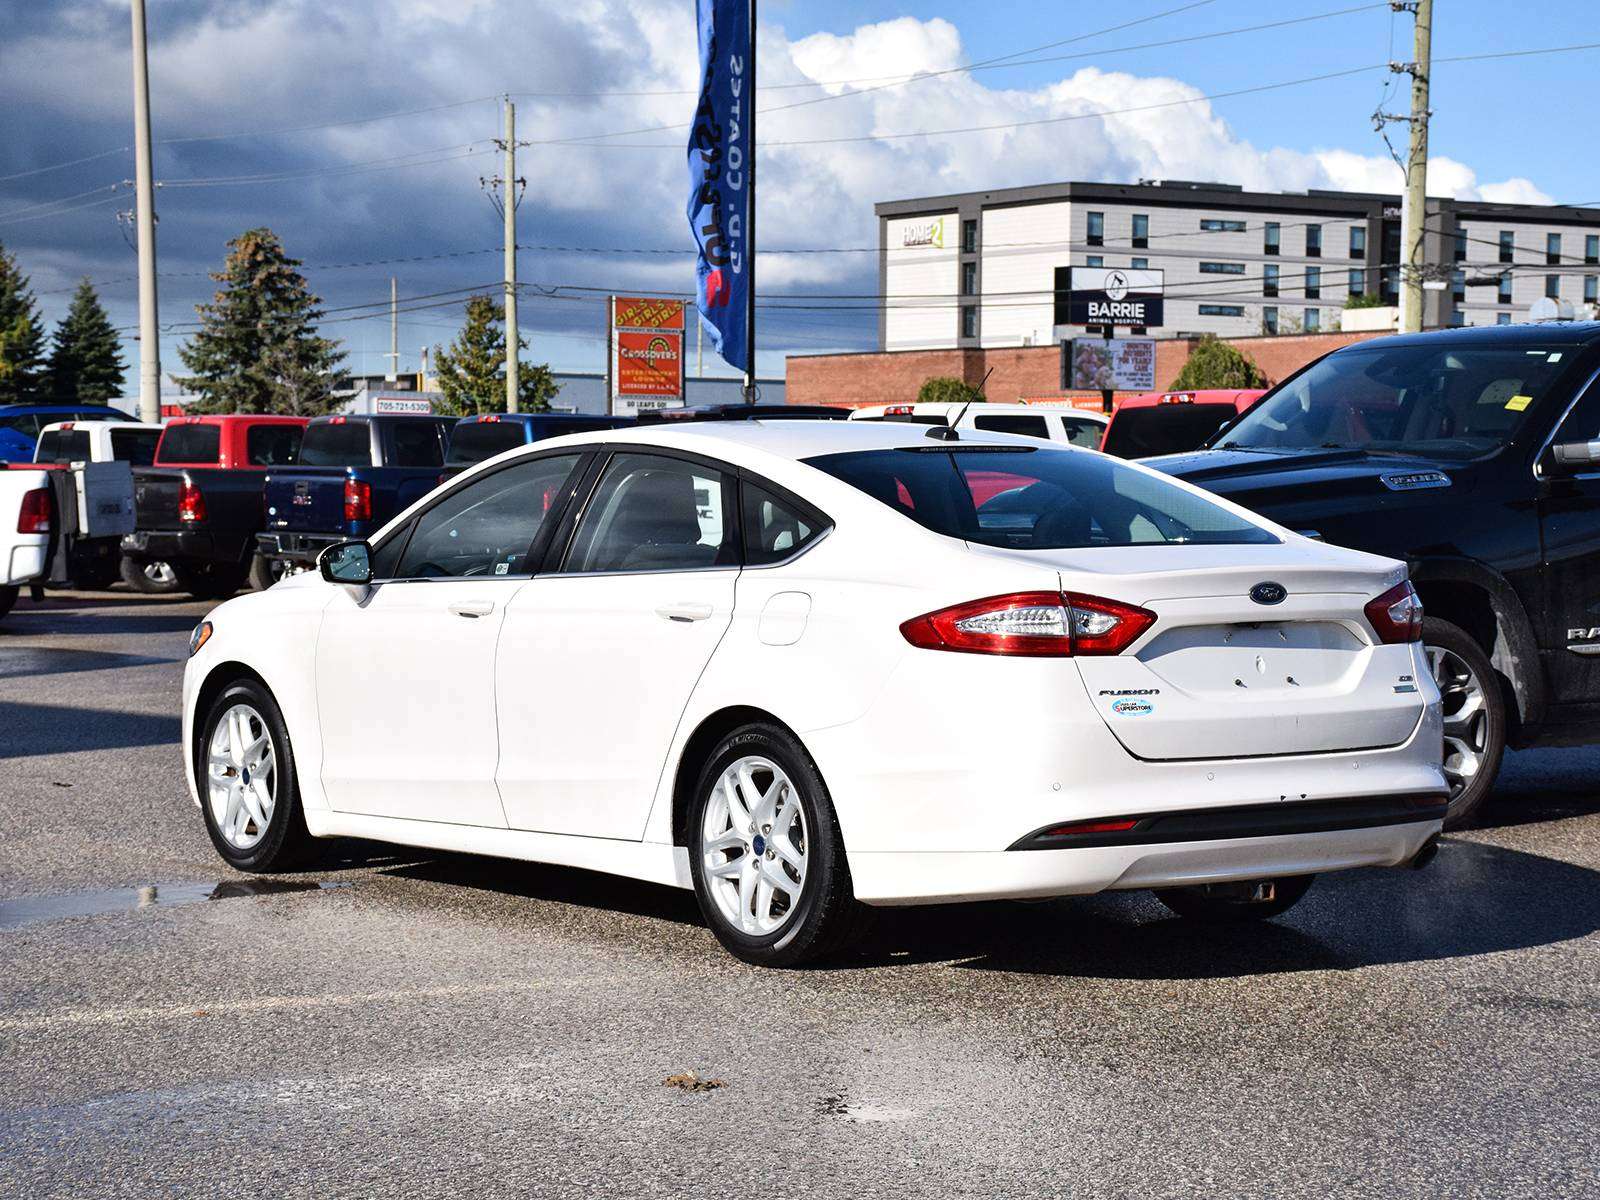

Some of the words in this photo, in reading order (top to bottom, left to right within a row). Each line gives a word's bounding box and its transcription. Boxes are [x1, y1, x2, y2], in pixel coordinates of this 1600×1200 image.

[616, 299, 648, 326] GIRLS
[634, 299, 665, 327] GIRLS
[652, 300, 683, 327] GIRLS
[1088, 302, 1145, 318] BARRIE
[379, 402, 429, 411] 705-721-5309
